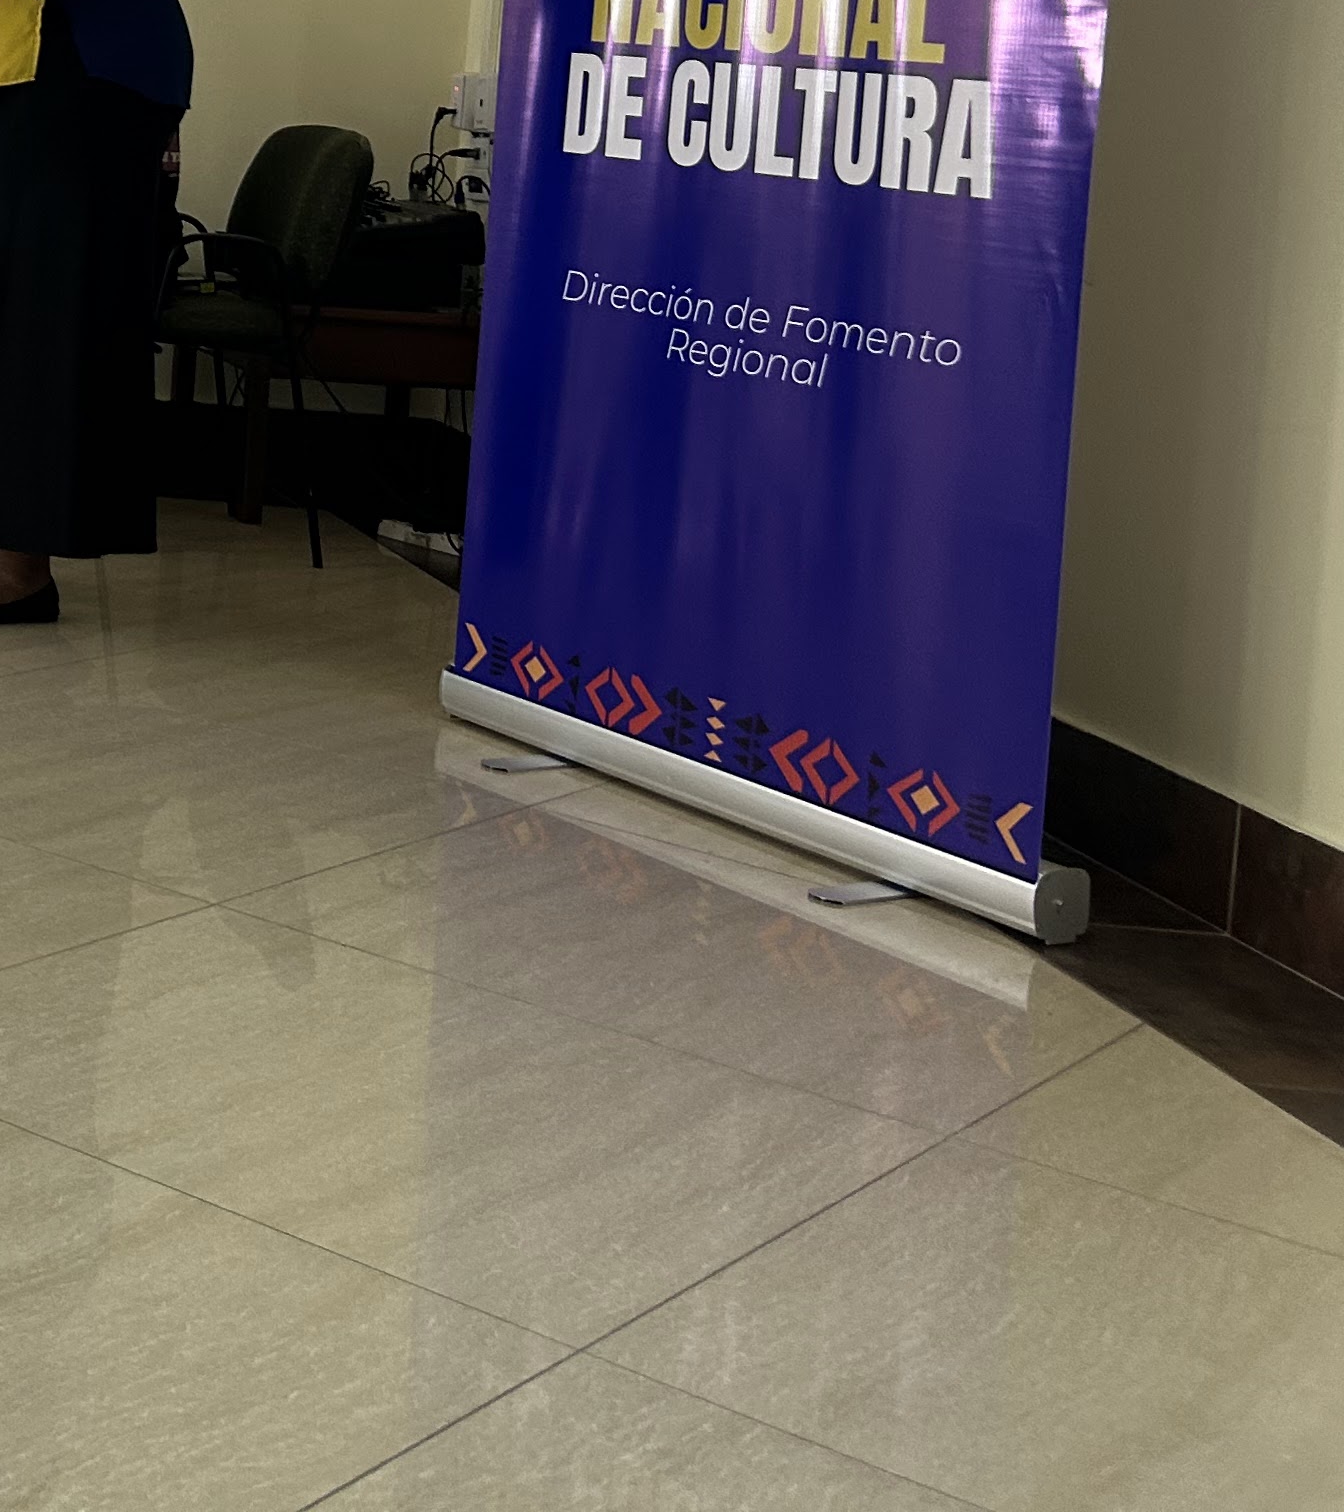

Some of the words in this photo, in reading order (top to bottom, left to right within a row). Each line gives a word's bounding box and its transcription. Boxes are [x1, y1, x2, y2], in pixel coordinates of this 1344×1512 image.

[562, 52, 647, 161] DE
[667, 59, 993, 199] CULTURA
[562, 270, 714, 326] Dirección
[724, 297, 770, 334] de
[781, 305, 963, 366] Fomento
[666, 328, 829, 388] Regional
